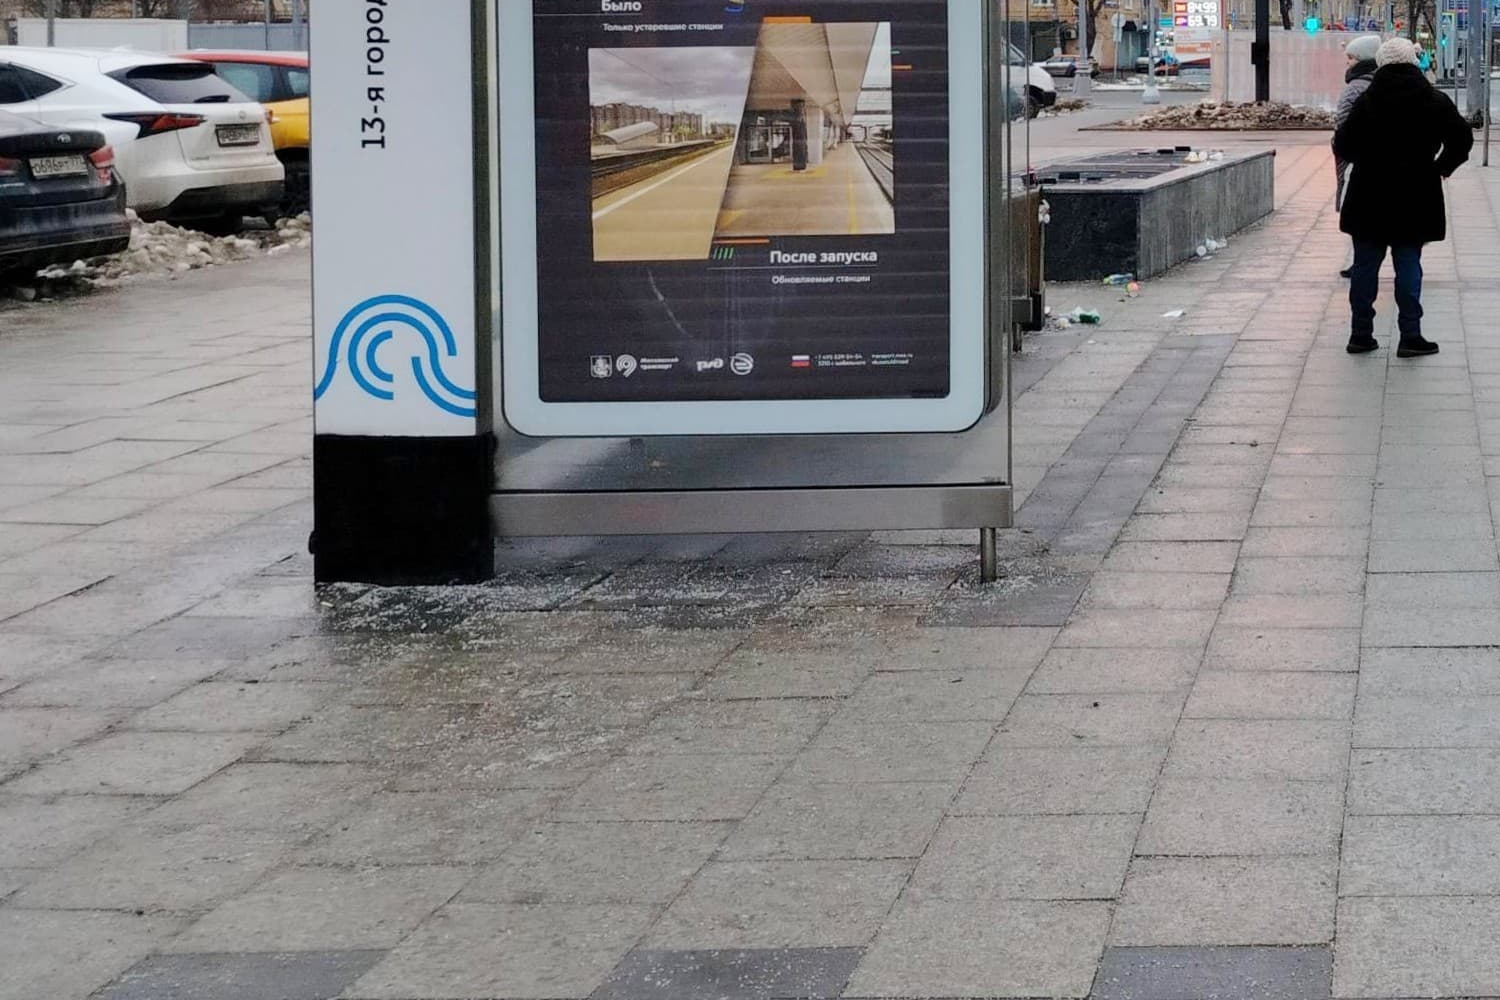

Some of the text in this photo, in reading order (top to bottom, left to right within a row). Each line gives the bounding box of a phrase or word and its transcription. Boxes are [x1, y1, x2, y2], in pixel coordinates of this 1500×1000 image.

[602, 22, 724, 34] Только устаревшие станции
[361, 86, 386, 149] 13-я
[769, 250, 878, 265] После запуска
